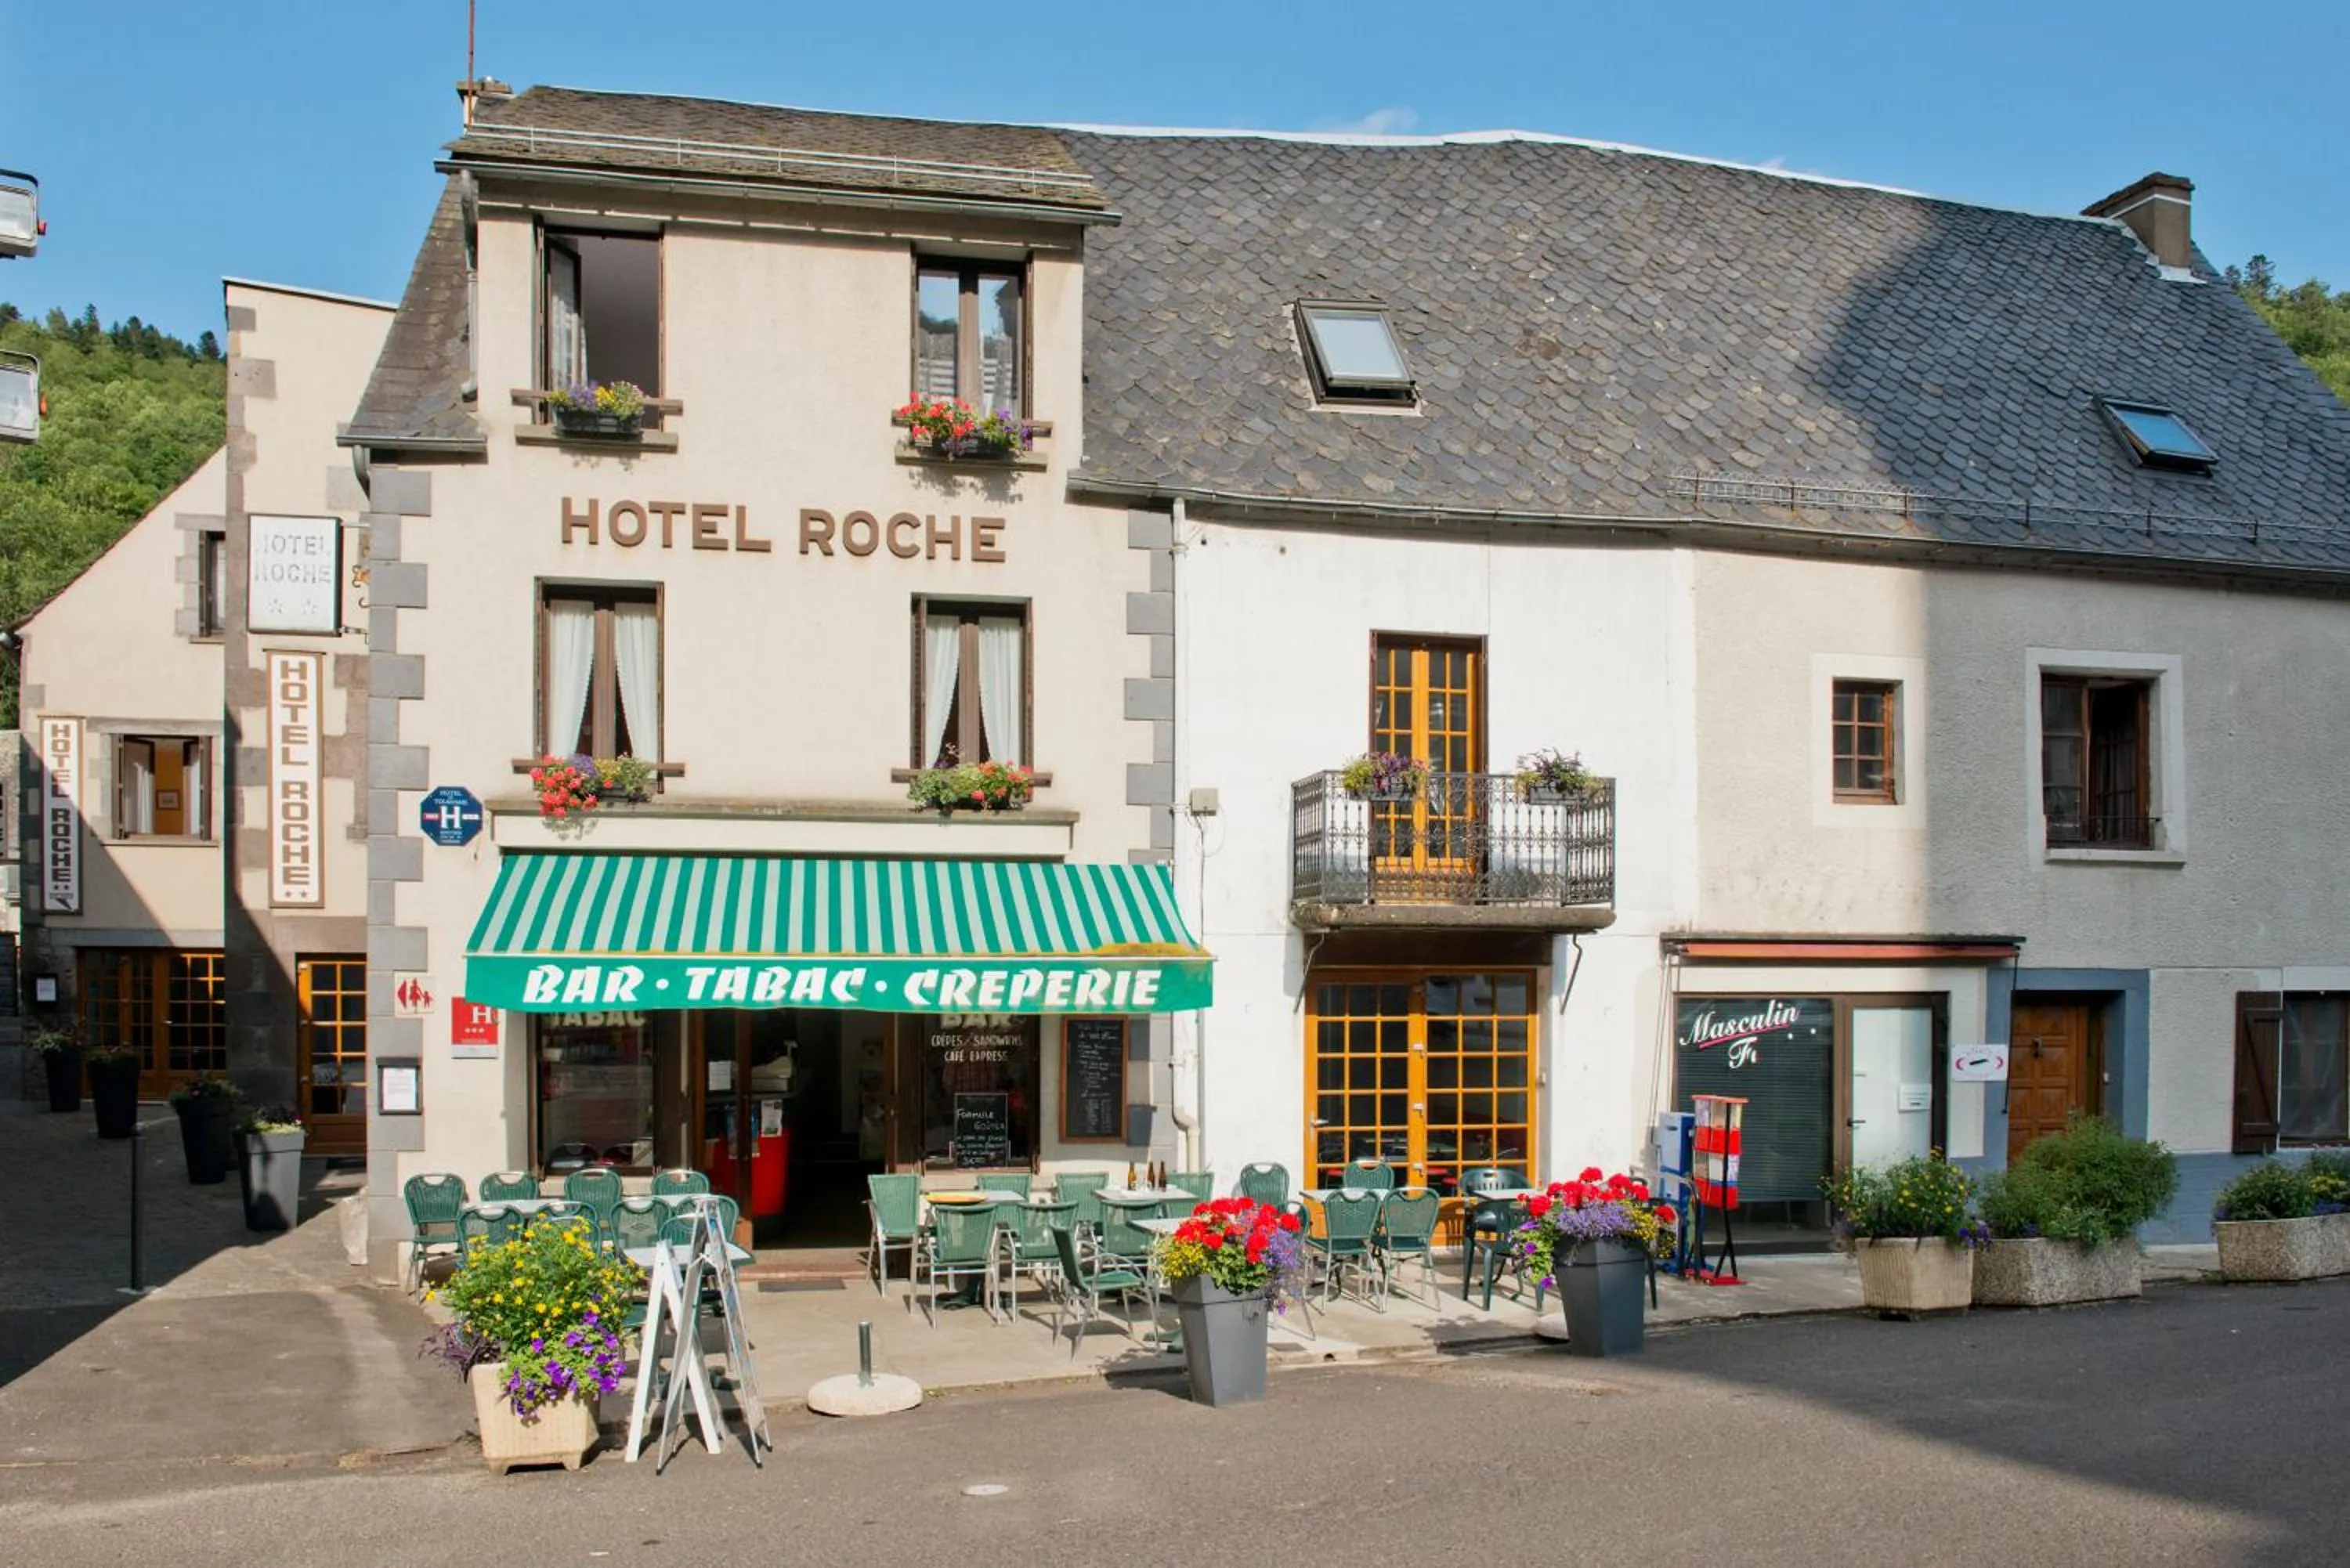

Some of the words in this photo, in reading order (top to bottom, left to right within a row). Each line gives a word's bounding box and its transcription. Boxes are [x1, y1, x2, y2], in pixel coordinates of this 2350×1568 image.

[562, 497, 772, 553] HOTEL
[799, 508, 1006, 563] ROCHE
[280, 660, 309, 766] HOTEL
[51, 724, 70, 798] HOTEL
[51, 807, 71, 883] ROCHE
[281, 781, 310, 886] ROCHE
[440, 805, 462, 829] H
[472, 1006, 492, 1024] H
[522, 964, 645, 1004] BAR
[685, 966, 867, 1003] TABAC
[903, 968, 1162, 1007] CREPERIE
[1679, 999, 1801, 1046] Masculin
